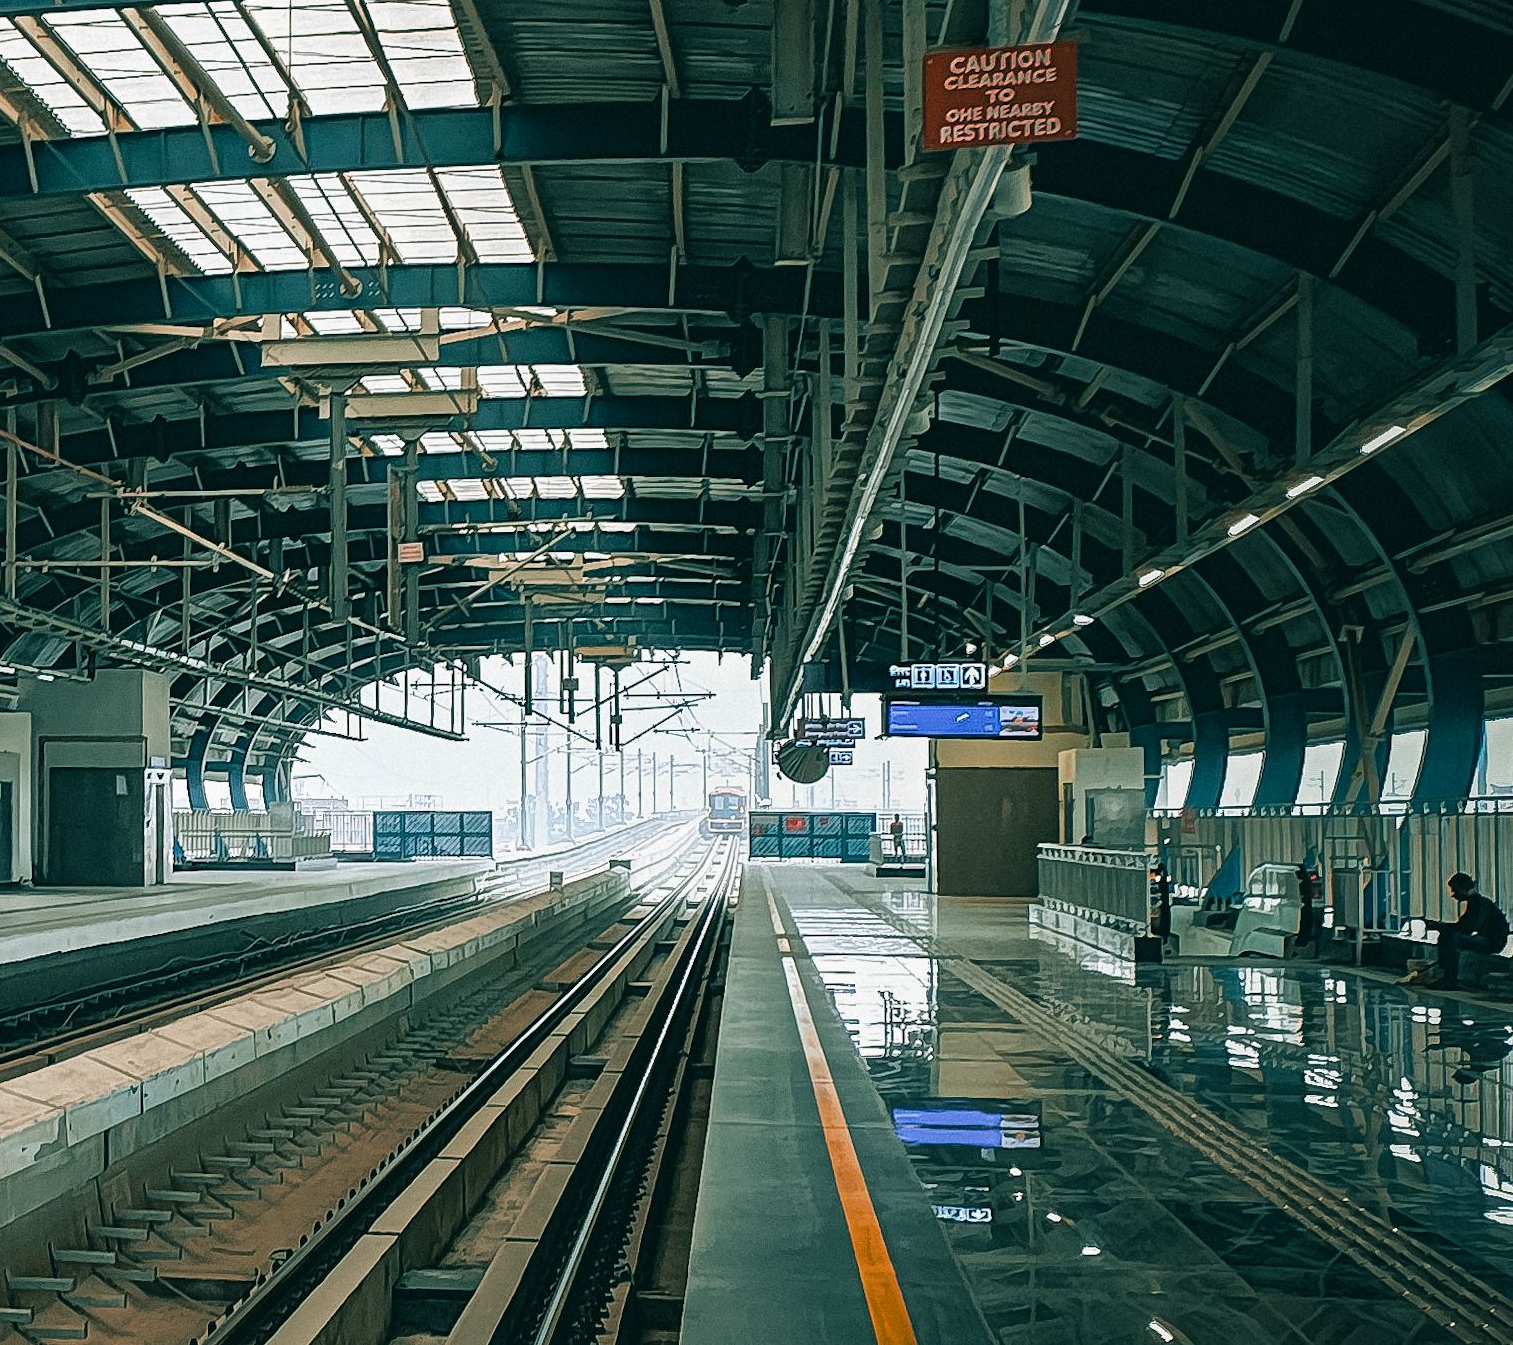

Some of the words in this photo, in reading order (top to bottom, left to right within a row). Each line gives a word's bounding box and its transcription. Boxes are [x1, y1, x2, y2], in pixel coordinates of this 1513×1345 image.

[949, 48, 1052, 74] CAUTION
[944, 67, 1058, 90] CLEARANCE
[985, 88, 1015, 104] TO
[986, 100, 1055, 120] NEARBY
[939, 117, 1062, 144] RESTRICTED
